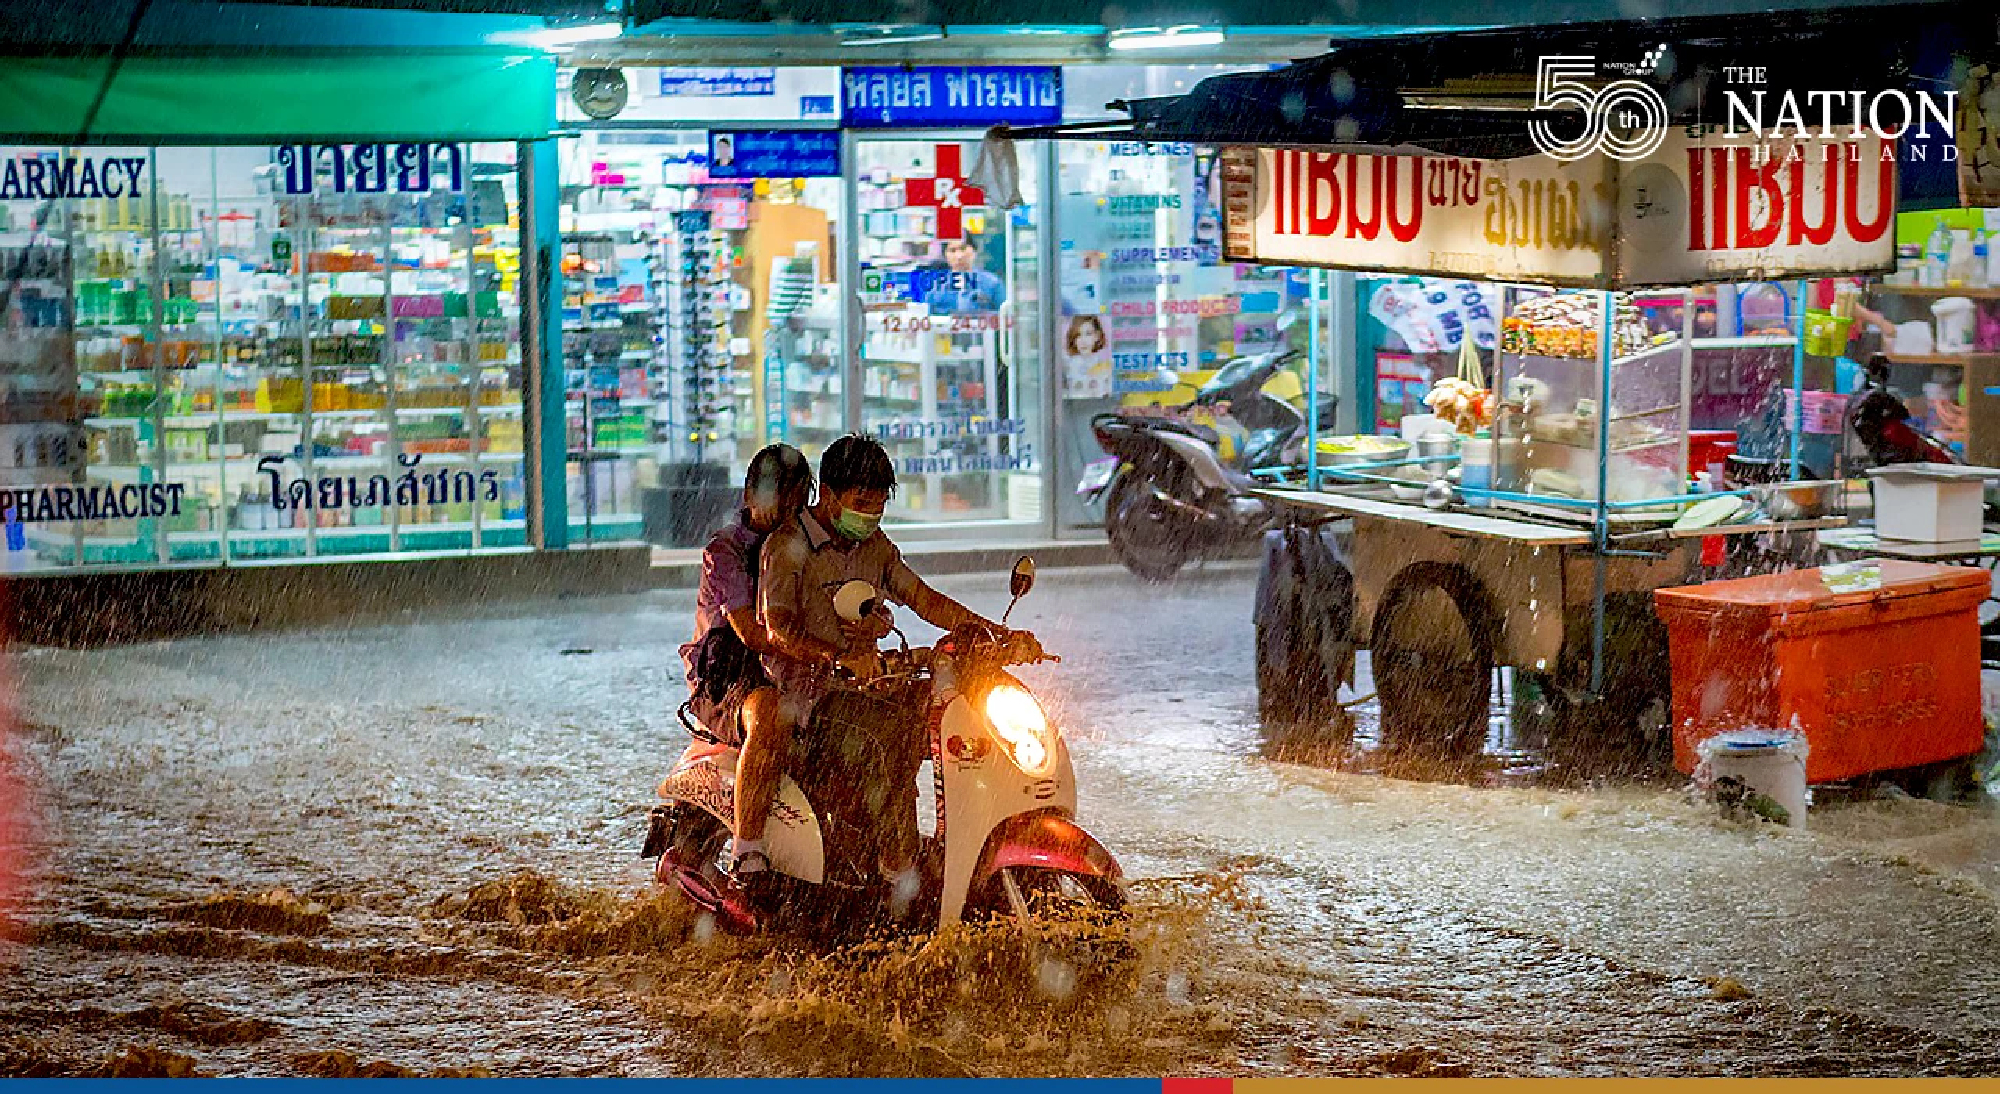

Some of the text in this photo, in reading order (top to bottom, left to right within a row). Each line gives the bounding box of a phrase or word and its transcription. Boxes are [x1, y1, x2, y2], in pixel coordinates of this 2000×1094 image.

[1110, 143, 1190, 156] MEDICINES
[0, 158, 145, 199] ARMACY
[278, 143, 461, 194] ขายยา
[1113, 246, 1220, 263] SUPPLEMENTS
[919, 271, 978, 291] OPEN
[1111, 297, 1240, 316] CHILD PRODUCTS
[1112, 352, 1188, 370] TEST KITS
[257, 452, 498, 510] โดยเภสัชกร
[0, 483, 185, 523] PHARMACIST
